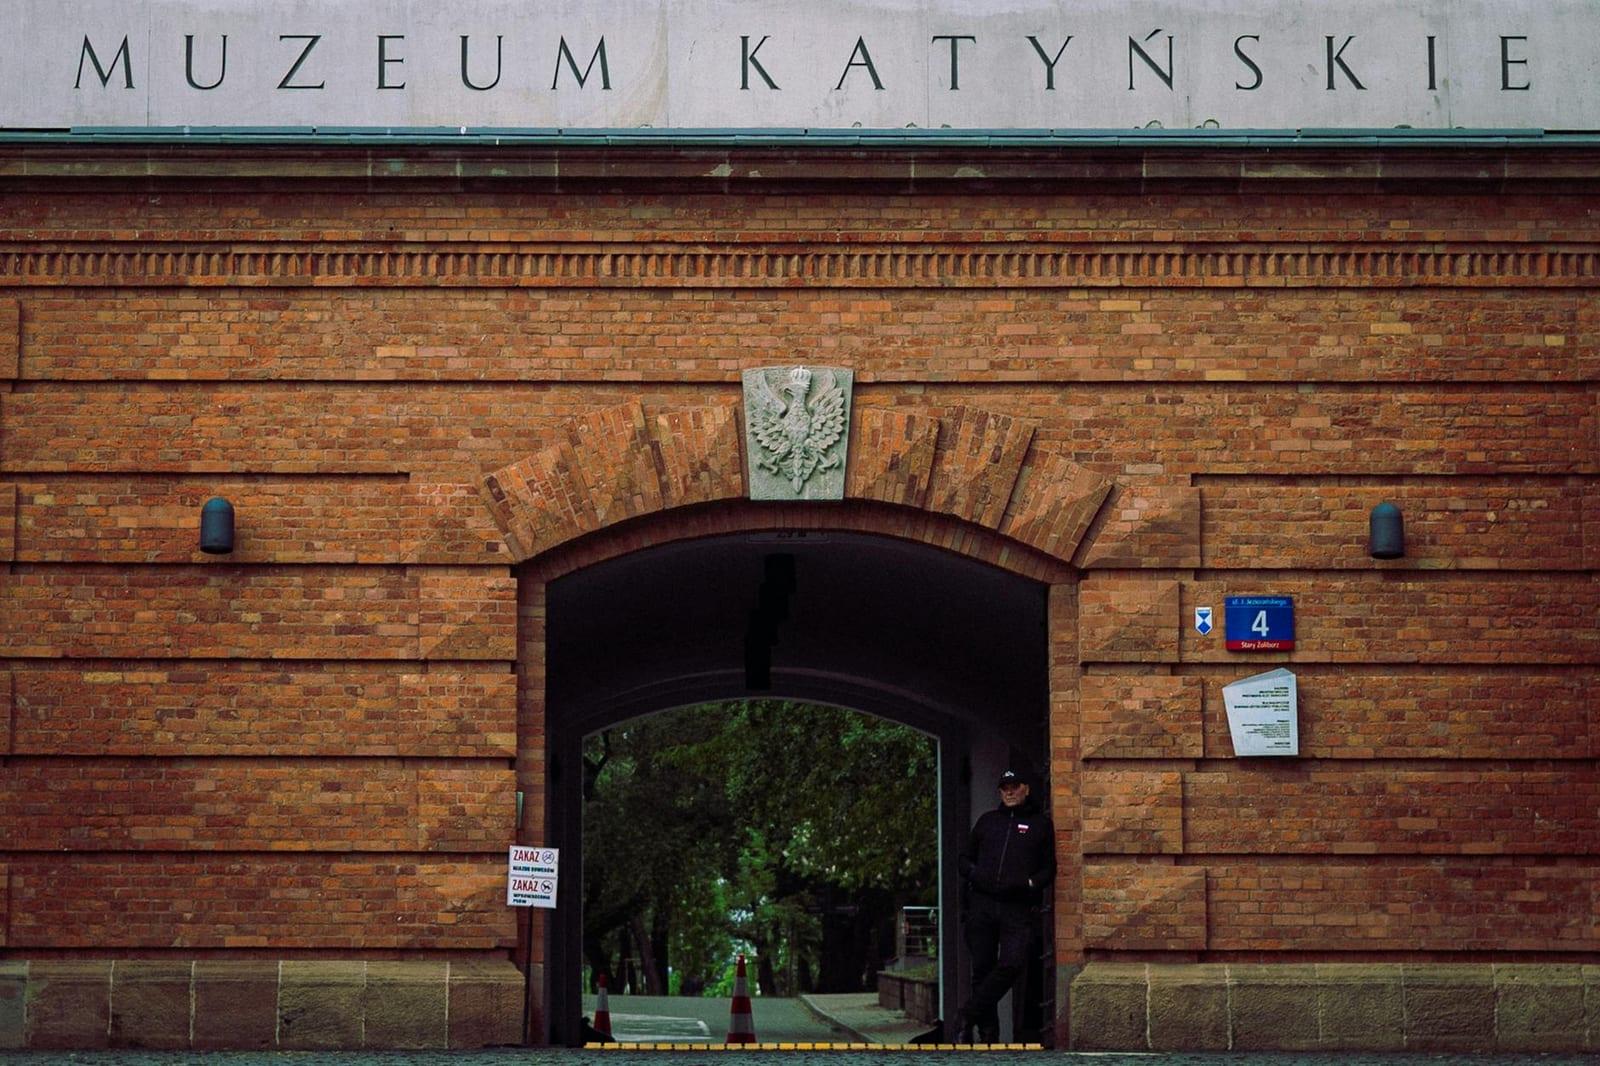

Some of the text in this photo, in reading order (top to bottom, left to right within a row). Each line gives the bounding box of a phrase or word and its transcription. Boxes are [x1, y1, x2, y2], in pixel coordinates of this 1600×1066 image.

[74, 28, 1531, 91] MUZEUM KATYŃSKIE
[1251, 610, 1270, 637] 4
[1240, 641, 1256, 650] Stary
[513, 849, 540, 862] ZAKAZ
[512, 879, 538, 892] ZAKAZ
